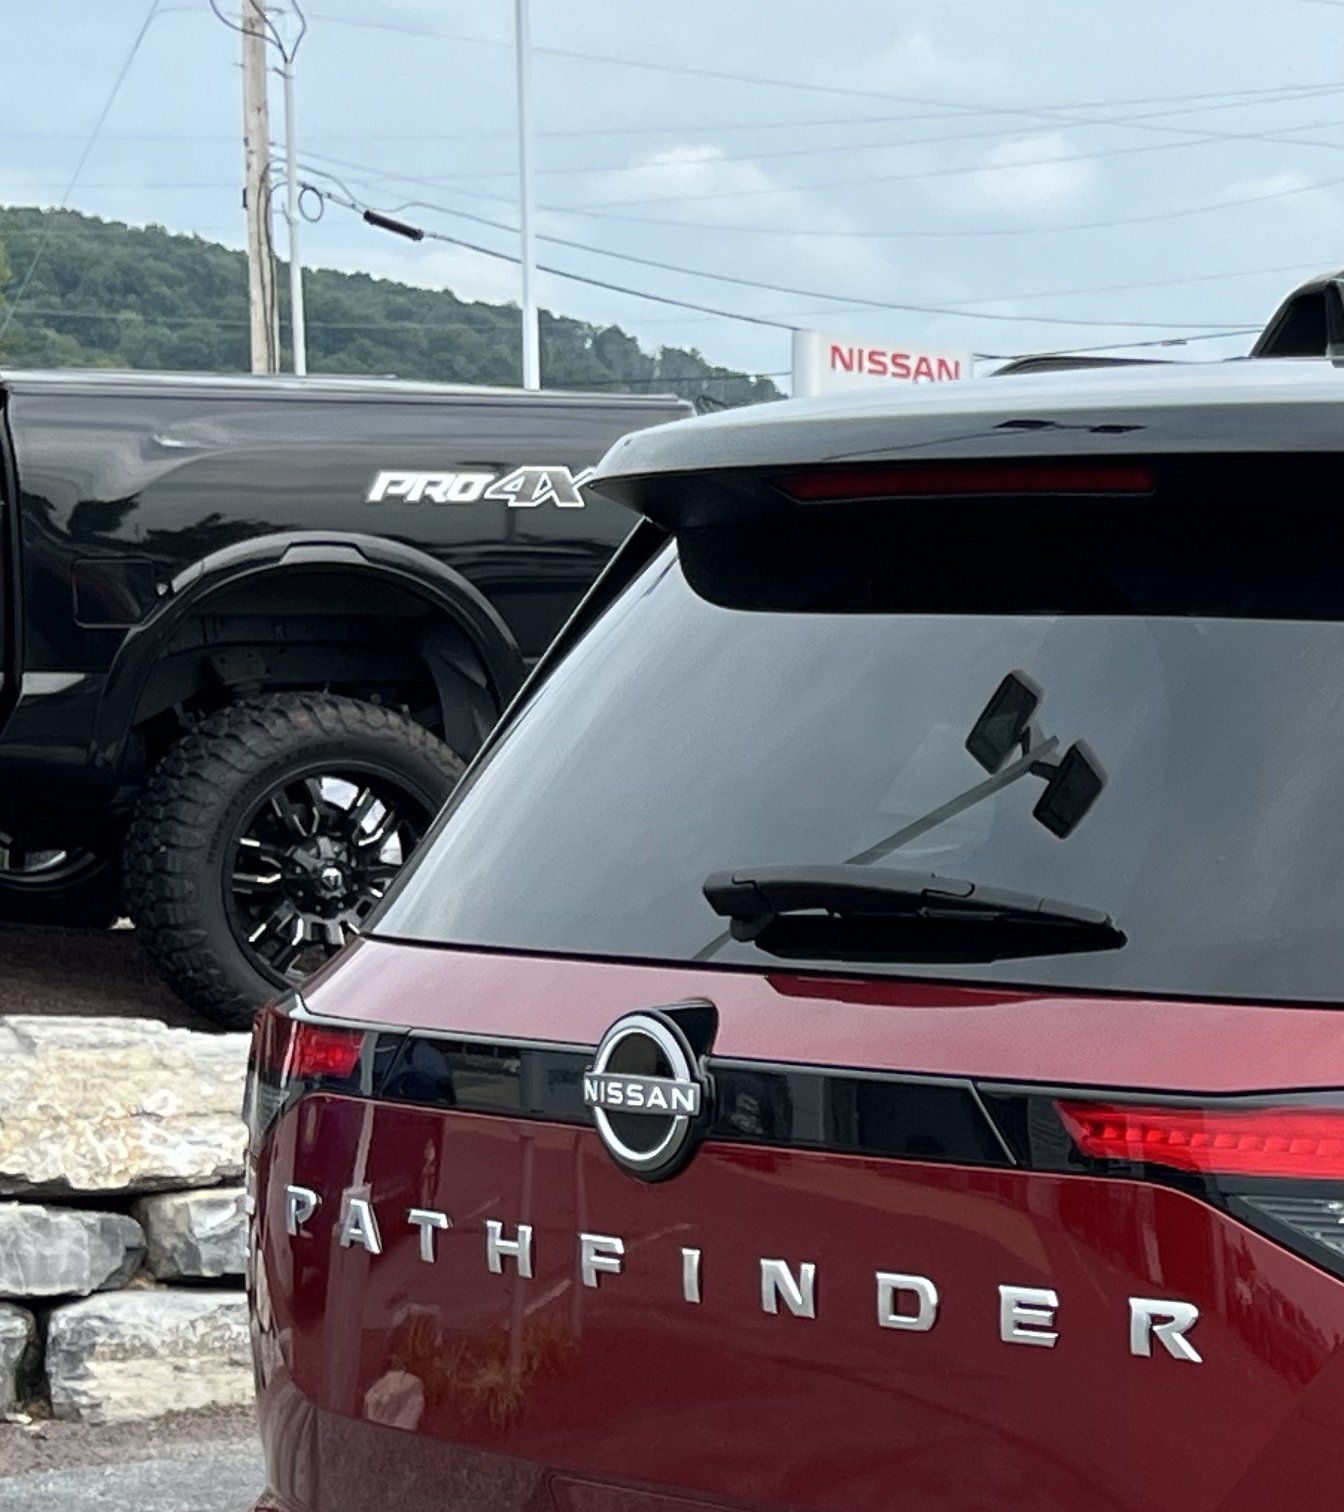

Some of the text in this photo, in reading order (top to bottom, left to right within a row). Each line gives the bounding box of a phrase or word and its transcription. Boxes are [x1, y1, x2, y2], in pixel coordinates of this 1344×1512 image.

[830, 344, 960, 384] NISSAN
[584, 1078, 695, 1112] NISSAN
[286, 1185, 1204, 1363] PATHFINDER
